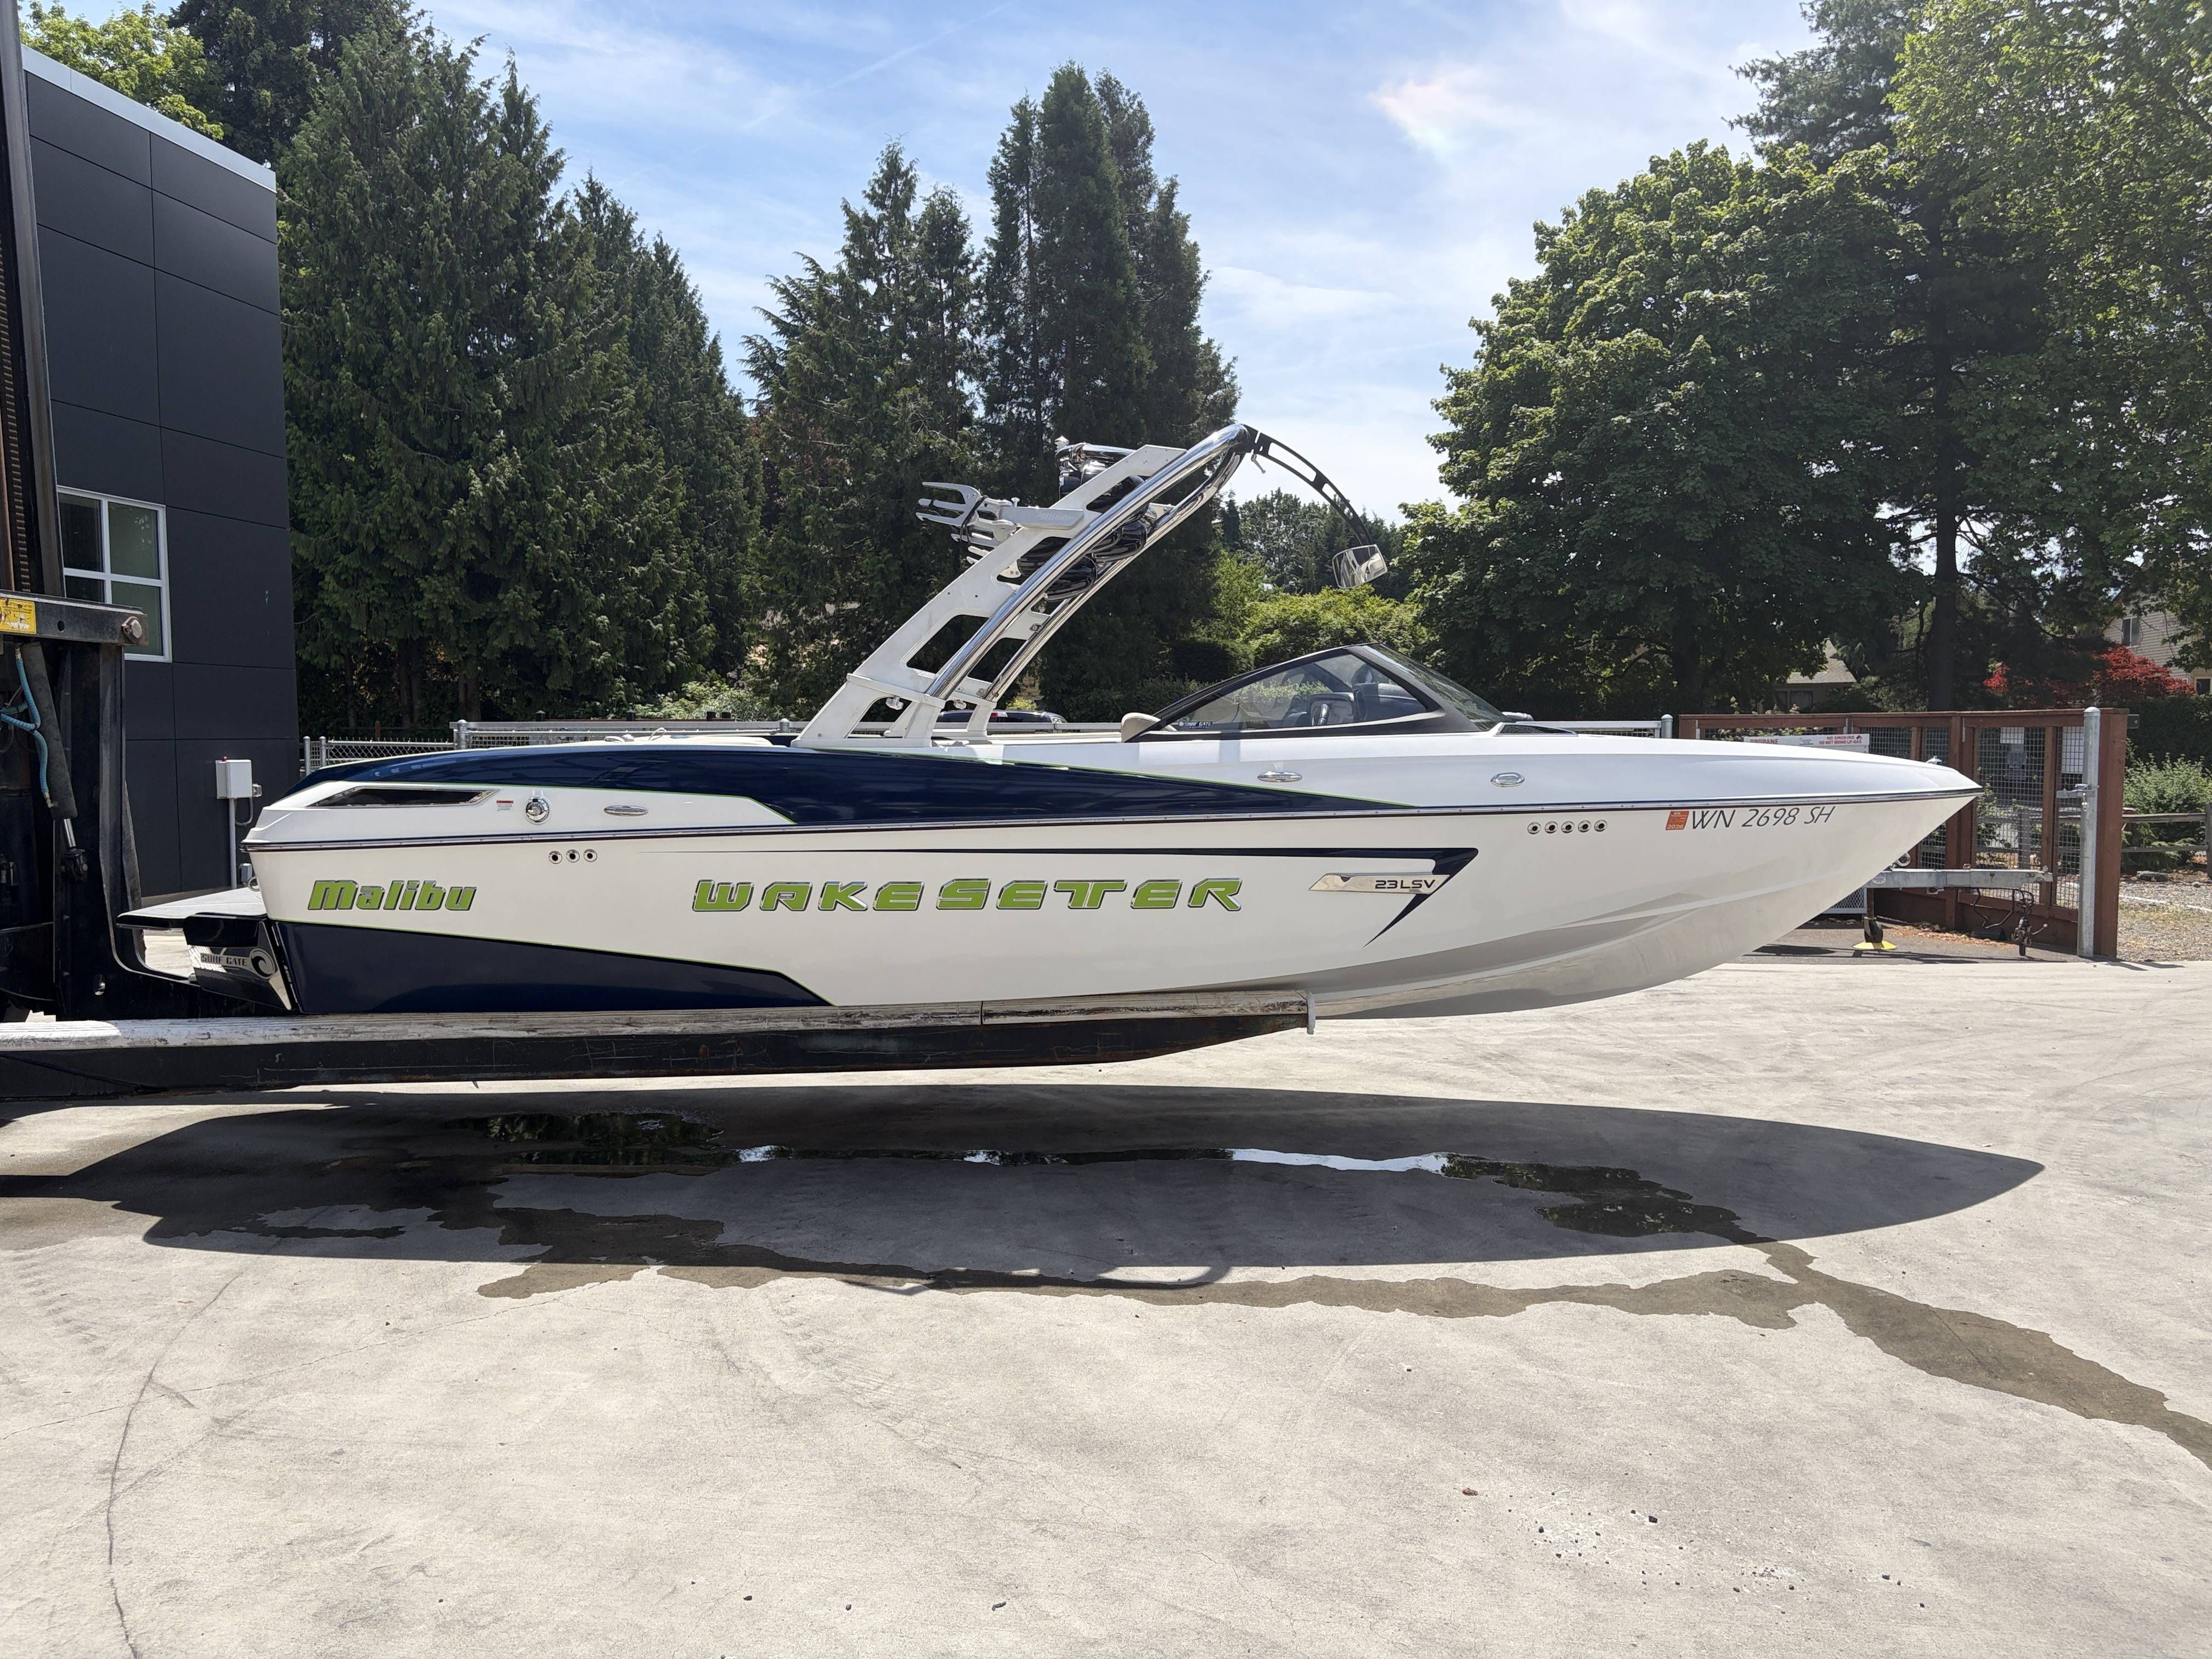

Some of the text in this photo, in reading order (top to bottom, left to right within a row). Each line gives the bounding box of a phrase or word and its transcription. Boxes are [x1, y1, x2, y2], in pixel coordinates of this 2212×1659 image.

[1692, 805, 1836, 830] WN 2698 SH
[307, 879, 477, 911] Malibu
[692, 878, 1243, 912] WAKESETTER
[201, 954, 247, 966] SURF GATE
